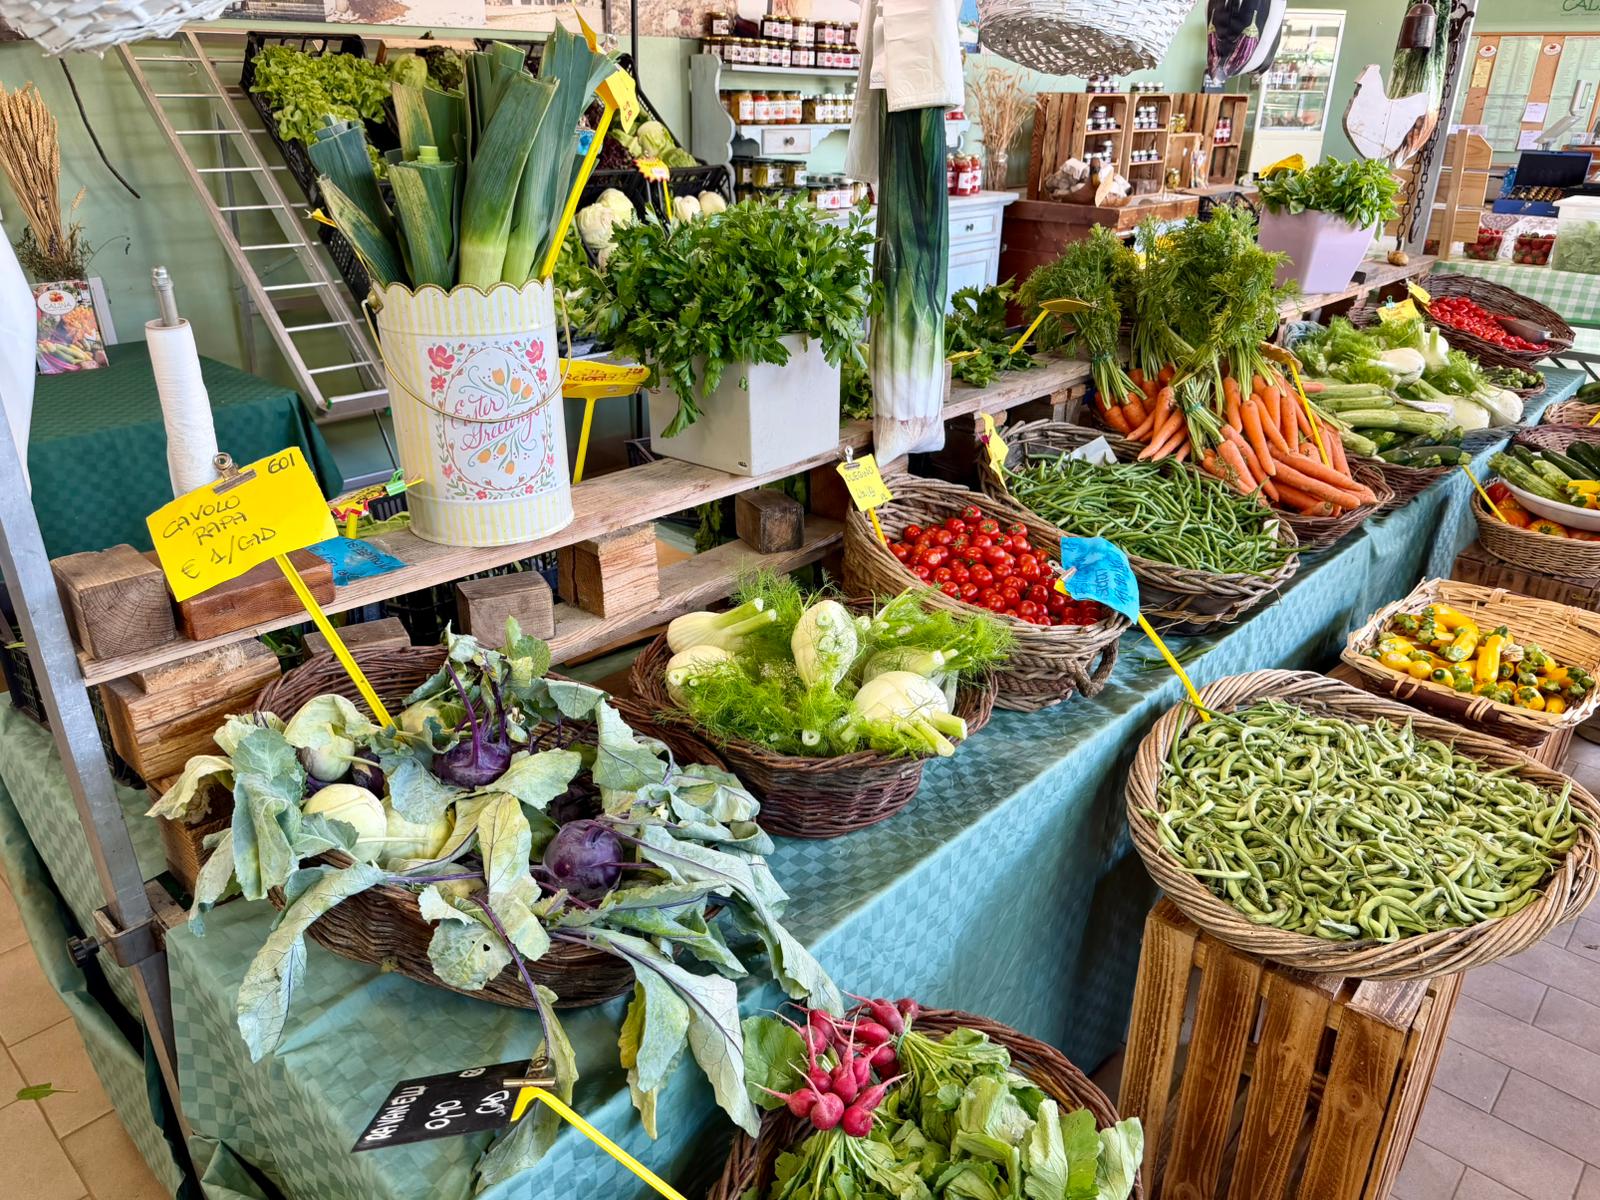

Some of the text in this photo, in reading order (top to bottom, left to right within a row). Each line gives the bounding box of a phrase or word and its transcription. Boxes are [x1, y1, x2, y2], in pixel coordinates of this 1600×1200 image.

[1562, 0, 1600, 11] CAL
[267, 453, 296, 475] 601
[162, 495, 241, 539] CAVOLO
[192, 511, 248, 546] RAPA
[181, 558, 201, 580] €
